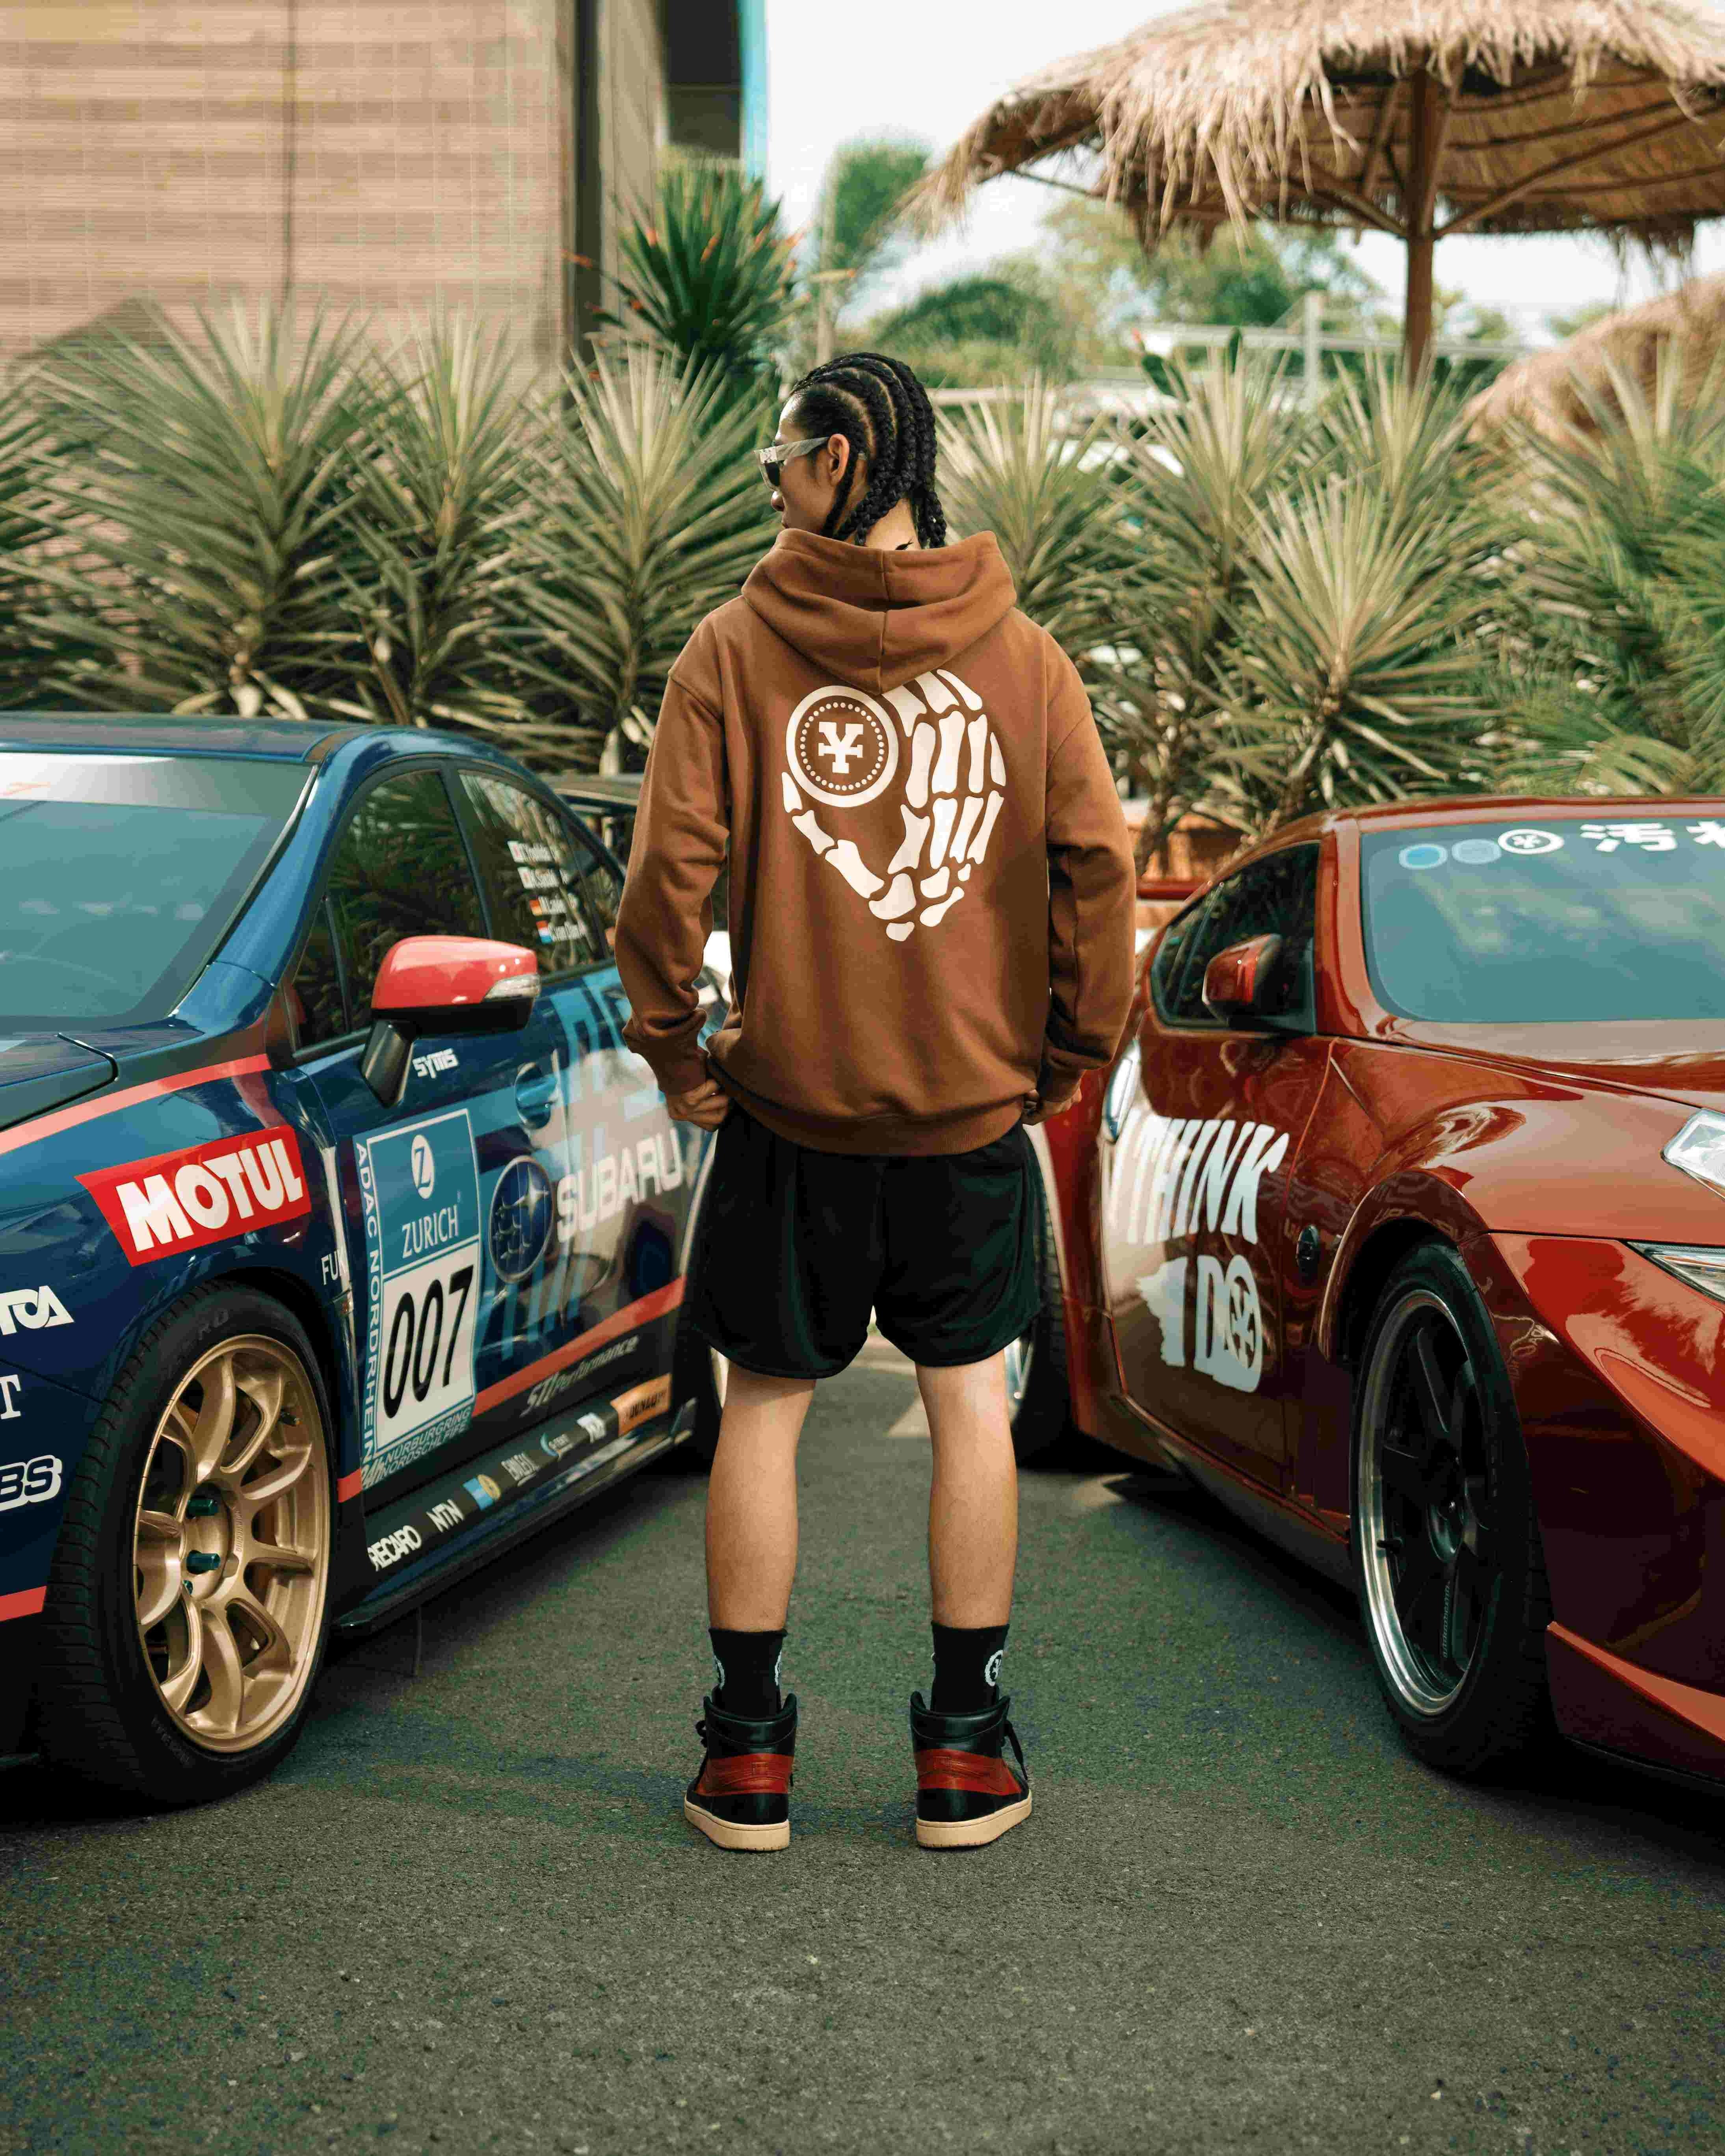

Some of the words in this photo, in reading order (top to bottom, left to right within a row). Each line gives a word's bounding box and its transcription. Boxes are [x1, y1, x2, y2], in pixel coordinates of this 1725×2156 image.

[115, 1139, 303, 1252] MOTUL
[356, 1142, 377, 1239] ADAC
[402, 1204, 459, 1259] ZURICH
[557, 1127, 684, 1243] SUBARU
[362, 1250, 380, 1465] NORDRHEIN
[383, 1264, 474, 1419] 007
[368, 1525, 422, 1571] RECARO
[426, 1499, 464, 1532] NTN
